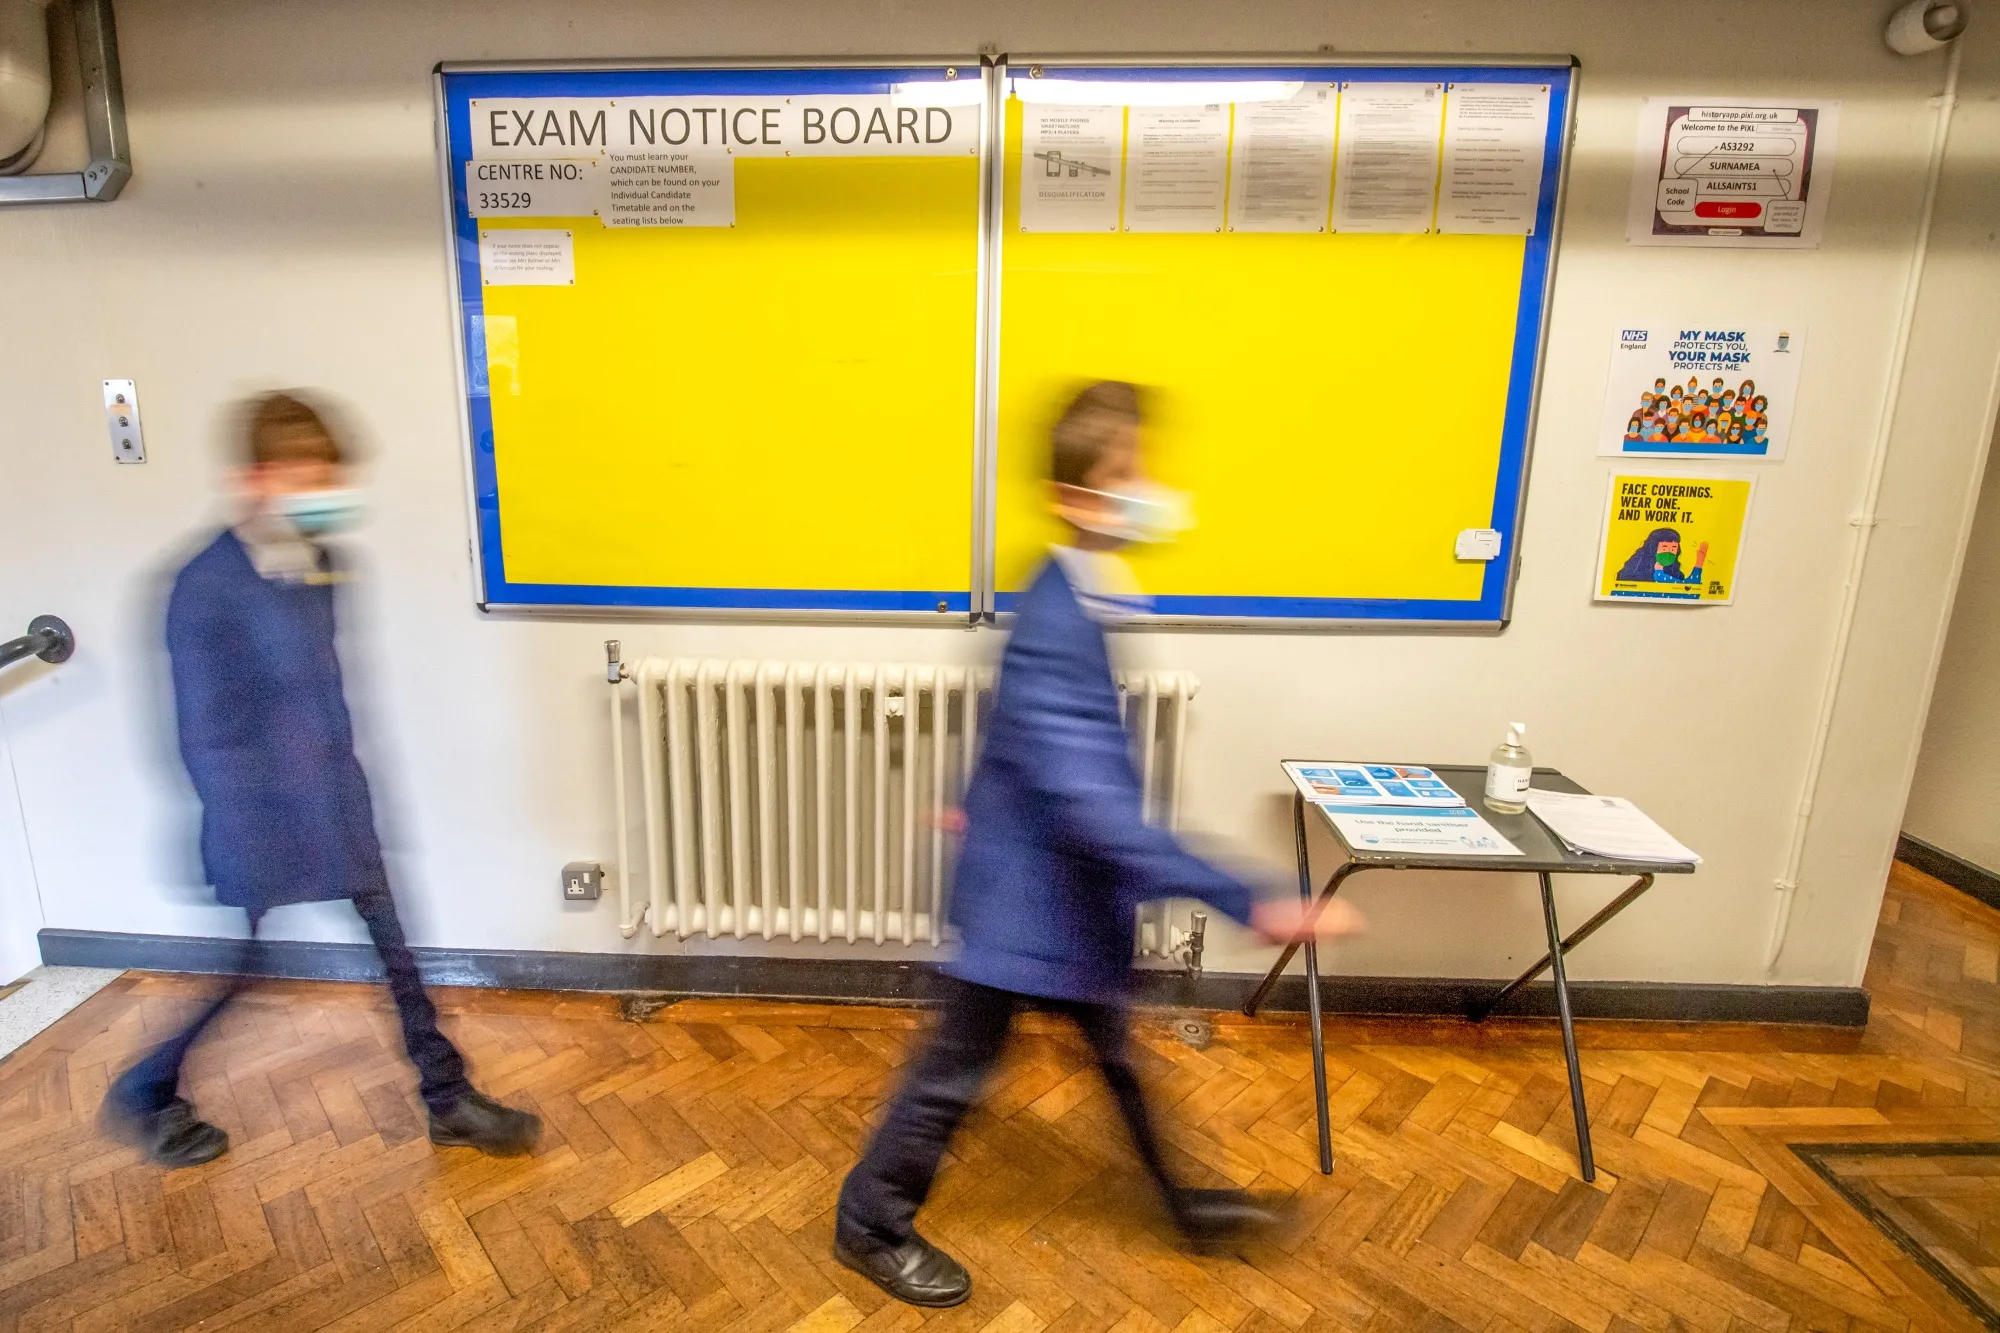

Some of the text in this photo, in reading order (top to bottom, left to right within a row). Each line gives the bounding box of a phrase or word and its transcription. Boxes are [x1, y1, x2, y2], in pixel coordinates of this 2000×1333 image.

[1701, 110, 1778, 120] historyapp.pixl.org.uk
[490, 107, 952, 146] EXAM NOTICE BOARD
[1681, 124, 1716, 132] Welcome
[1740, 124, 1755, 132] PiXL
[1720, 142, 1754, 151] AS3292
[610, 154, 624, 162] You
[648, 153, 668, 161] learn
[670, 154, 688, 162] your
[610, 166, 696, 174] CANDIDATE NUMBER,
[1710, 162, 1760, 171] SURNAMEA
[478, 164, 583, 181] CENTRE NO:
[610, 178, 634, 186] which
[652, 178, 661, 186] be
[663, 178, 686, 186] found
[701, 180, 720, 188] your
[611, 190, 691, 199] Individual Candidate
[480, 192, 532, 209] 33529
[612, 204, 650, 212] Timetable
[652, 204, 668, 212] and
[682, 204, 695, 212] the
[1718, 206, 1737, 214] Login
[612, 216, 683, 226] seating lists below
[1622, 330, 1647, 341] NHS
[1680, 330, 1746, 342] MY MASK
[1674, 342, 1748, 352] PROTECTS YOU,
[1668, 351, 1751, 363] YOUR MASK
[1674, 362, 1723, 370] PROTECTS
[1622, 483, 1713, 498] FACE COVERINGS.
[1620, 496, 1681, 510] WEAR ONE.
[1618, 509, 1694, 523] AND WORK IT.
